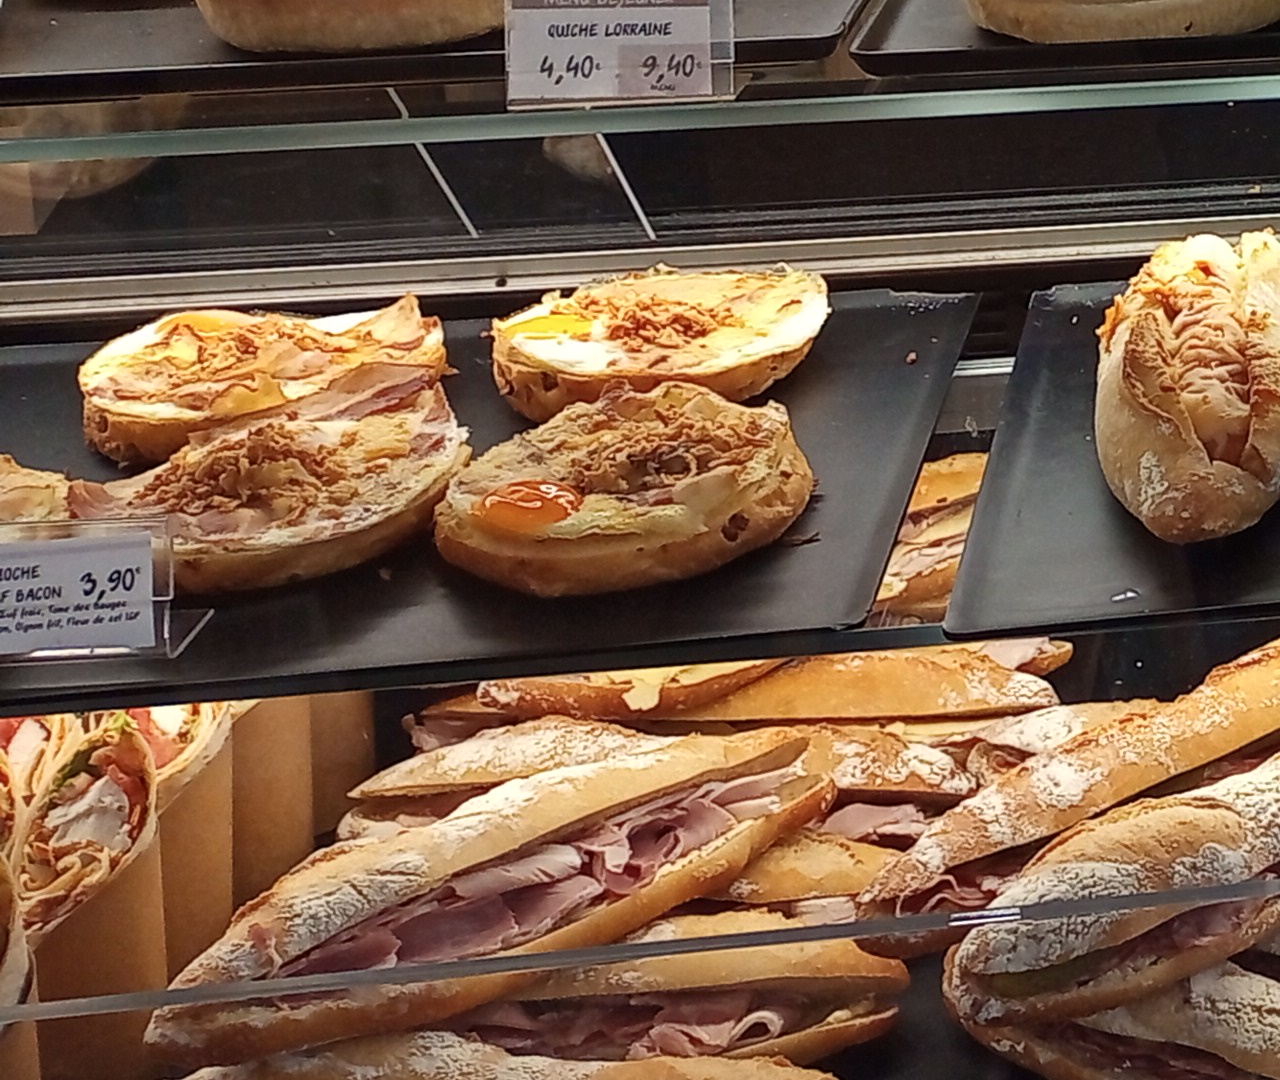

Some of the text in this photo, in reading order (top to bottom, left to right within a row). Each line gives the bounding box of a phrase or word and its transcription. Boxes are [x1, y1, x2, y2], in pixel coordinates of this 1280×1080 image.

[547, 21, 673, 38] QUICHE LORRAINE
[15, 586, 62, 603] BACON
